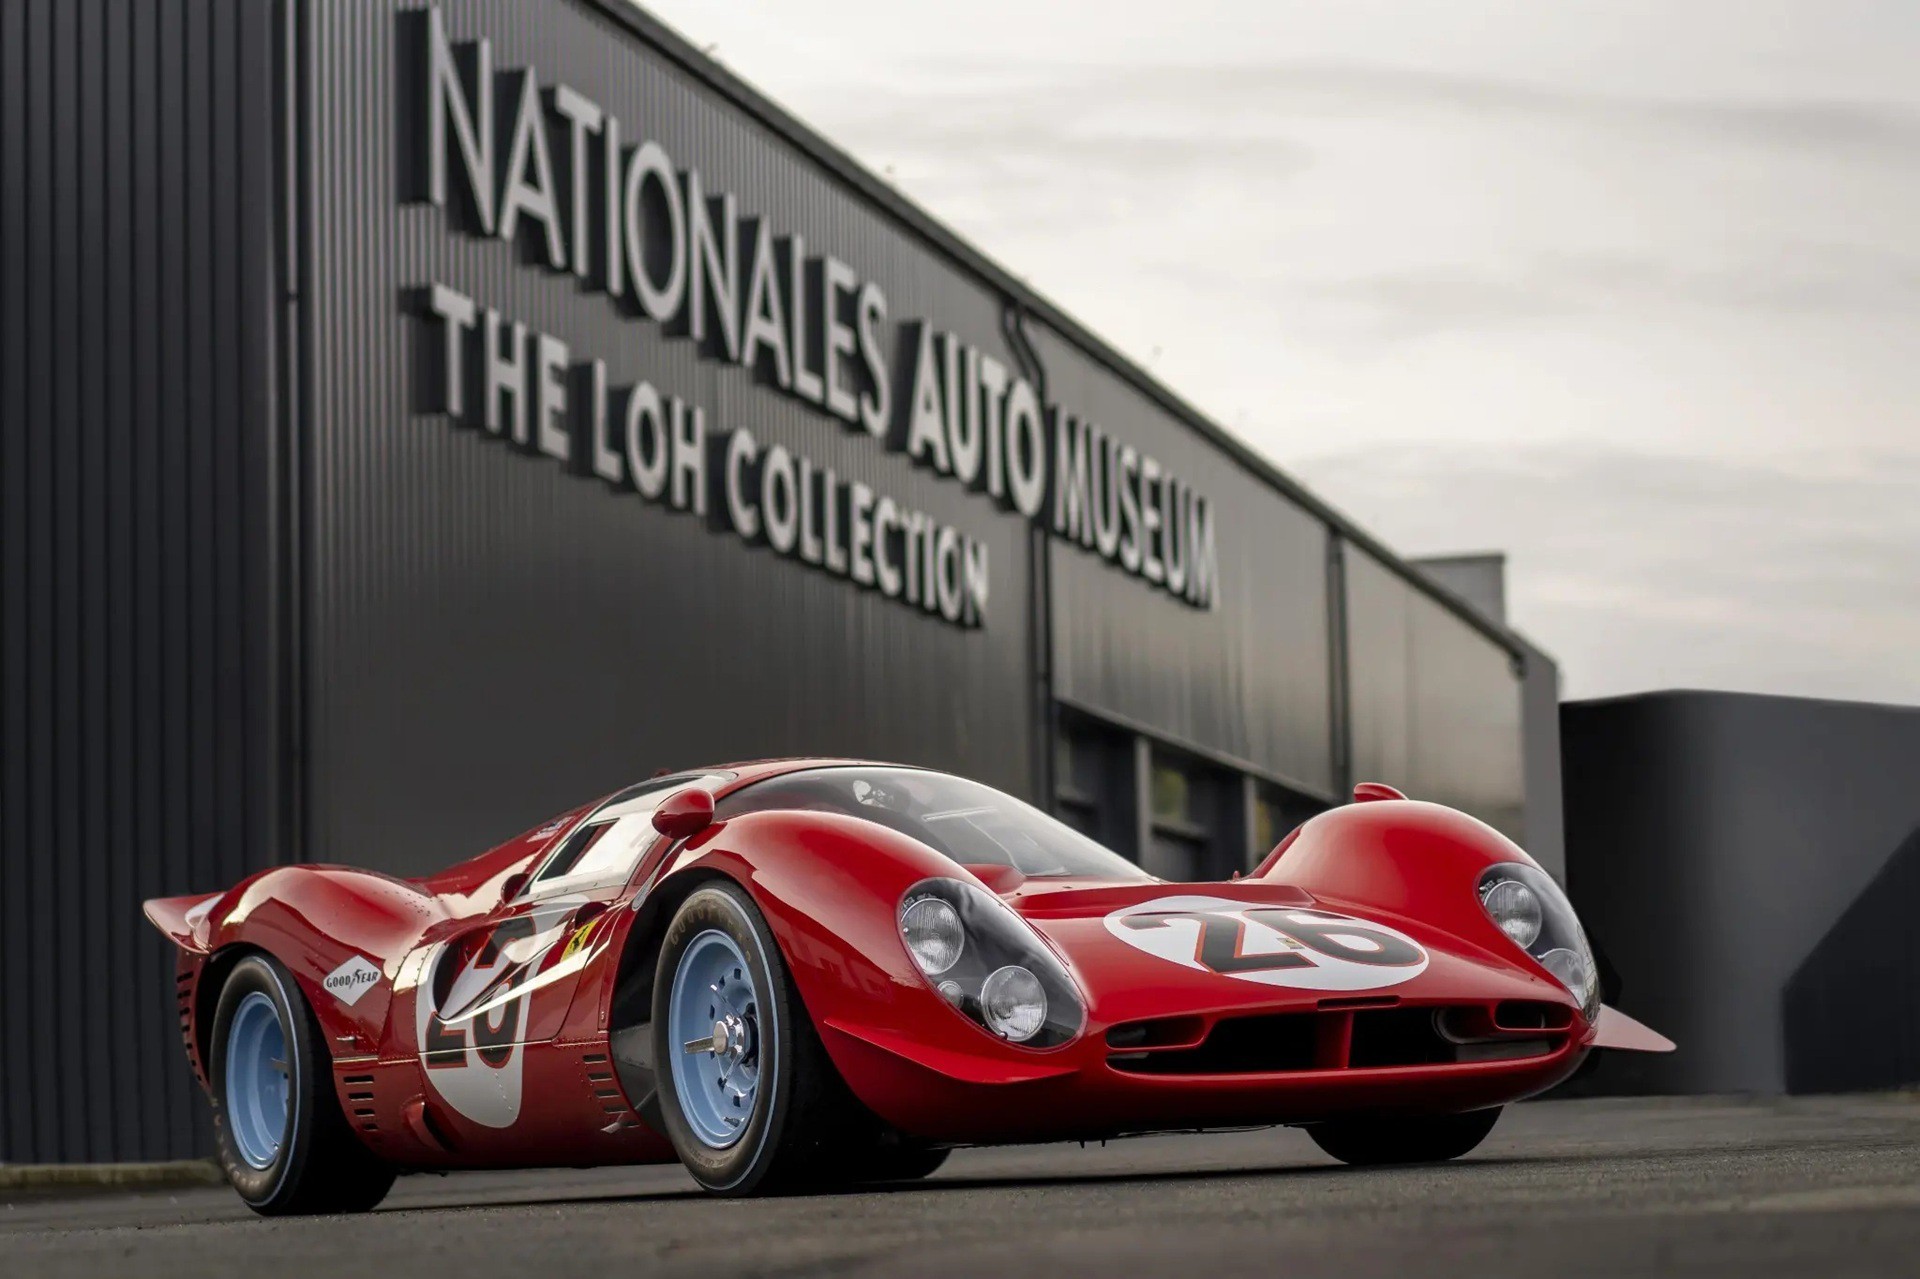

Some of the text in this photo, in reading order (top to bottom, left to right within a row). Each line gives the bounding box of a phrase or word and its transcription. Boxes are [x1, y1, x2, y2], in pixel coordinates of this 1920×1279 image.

[429, 6, 1219, 611] NATIONALES AUTO MUSEUM
[431, 283, 988, 625] THE LOH COLLECTION
[326, 968, 379, 990] GOODYEAR
[1119, 908, 1426, 975] 26
